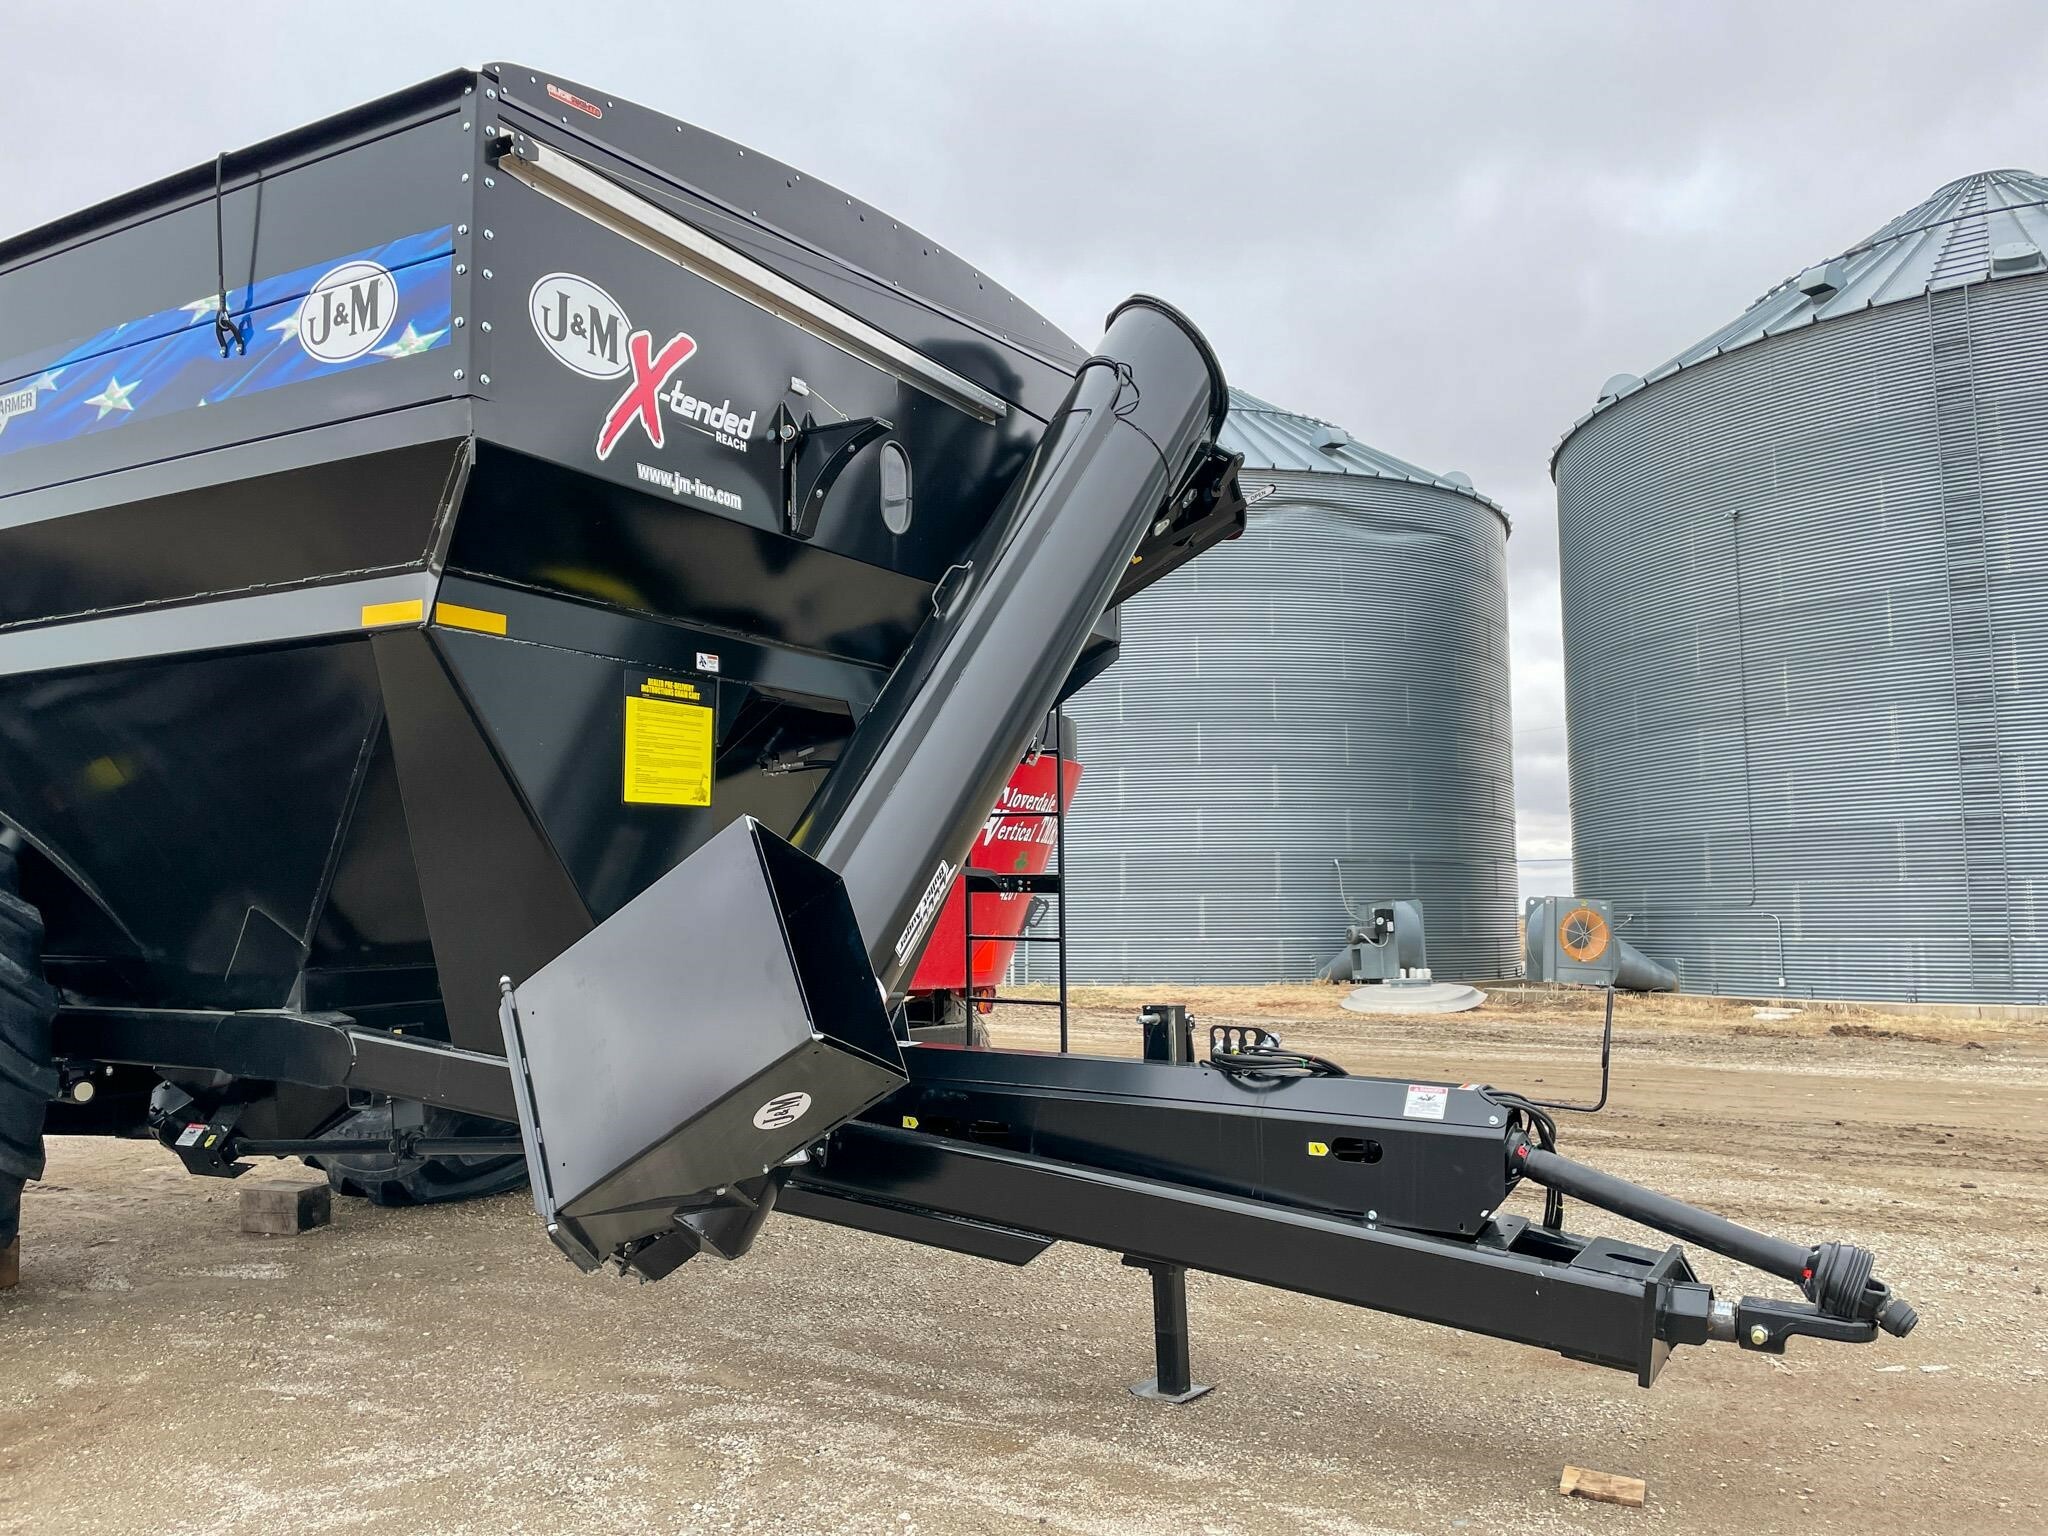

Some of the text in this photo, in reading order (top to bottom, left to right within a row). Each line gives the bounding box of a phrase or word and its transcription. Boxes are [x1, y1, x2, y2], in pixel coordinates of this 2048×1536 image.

[307, 278, 381, 346] J&M
[541, 290, 620, 365] J&M
[596, 330, 757, 461] X-tended
[715, 432, 747, 452] REACH
[636, 462, 743, 511] www.jm-inc.com
[1250, 490, 1267, 501] OPEN
[983, 809, 1038, 846] Vertical
[763, 1094, 803, 1126] J&M
